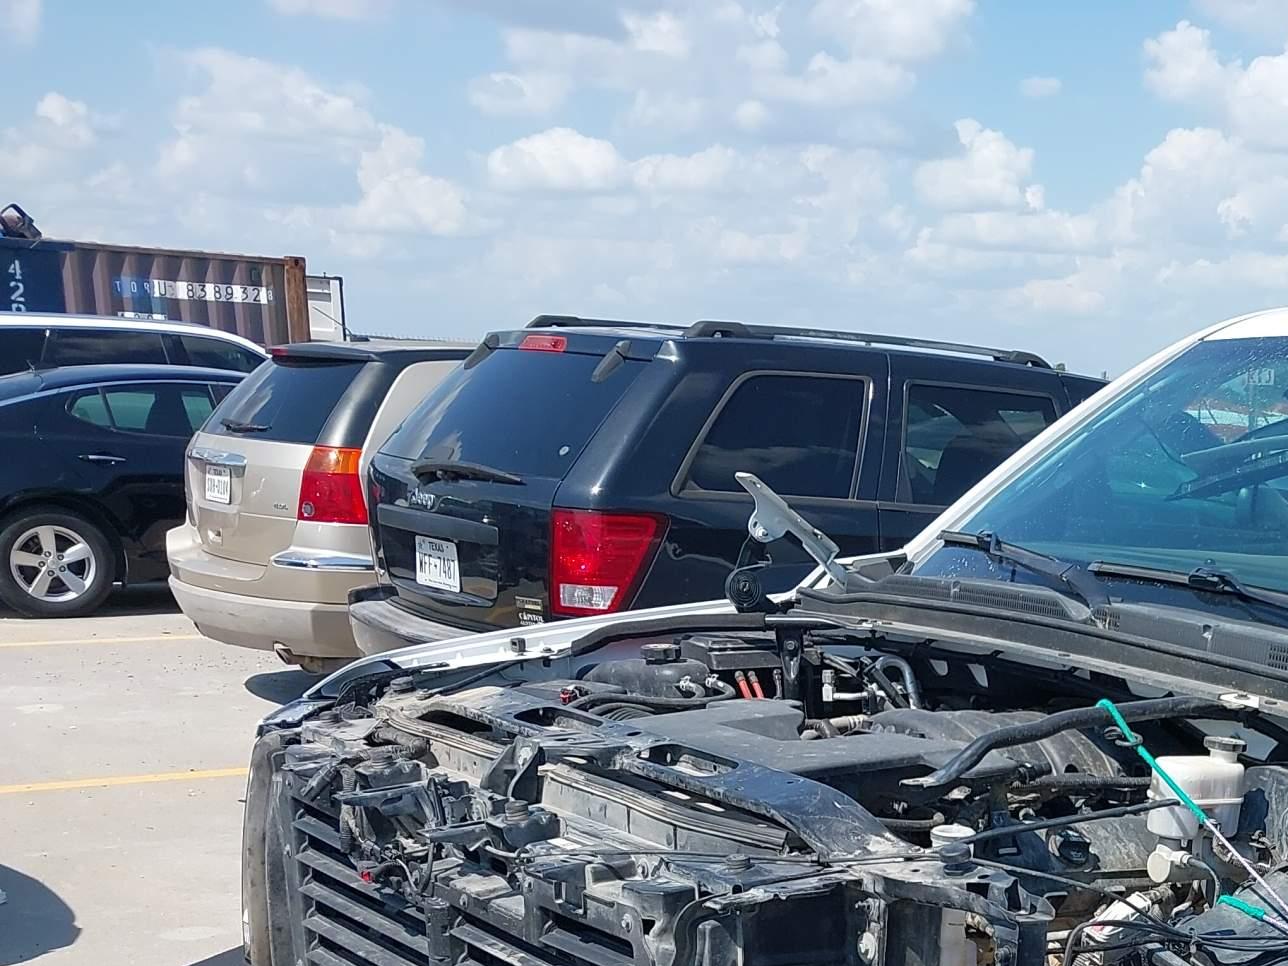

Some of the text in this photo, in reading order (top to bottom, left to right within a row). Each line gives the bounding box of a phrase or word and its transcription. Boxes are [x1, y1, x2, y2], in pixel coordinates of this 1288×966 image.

[186, 283, 261, 302] 838932
[410, 487, 436, 510] Jeep
[428, 541, 445, 553] TEXAS
